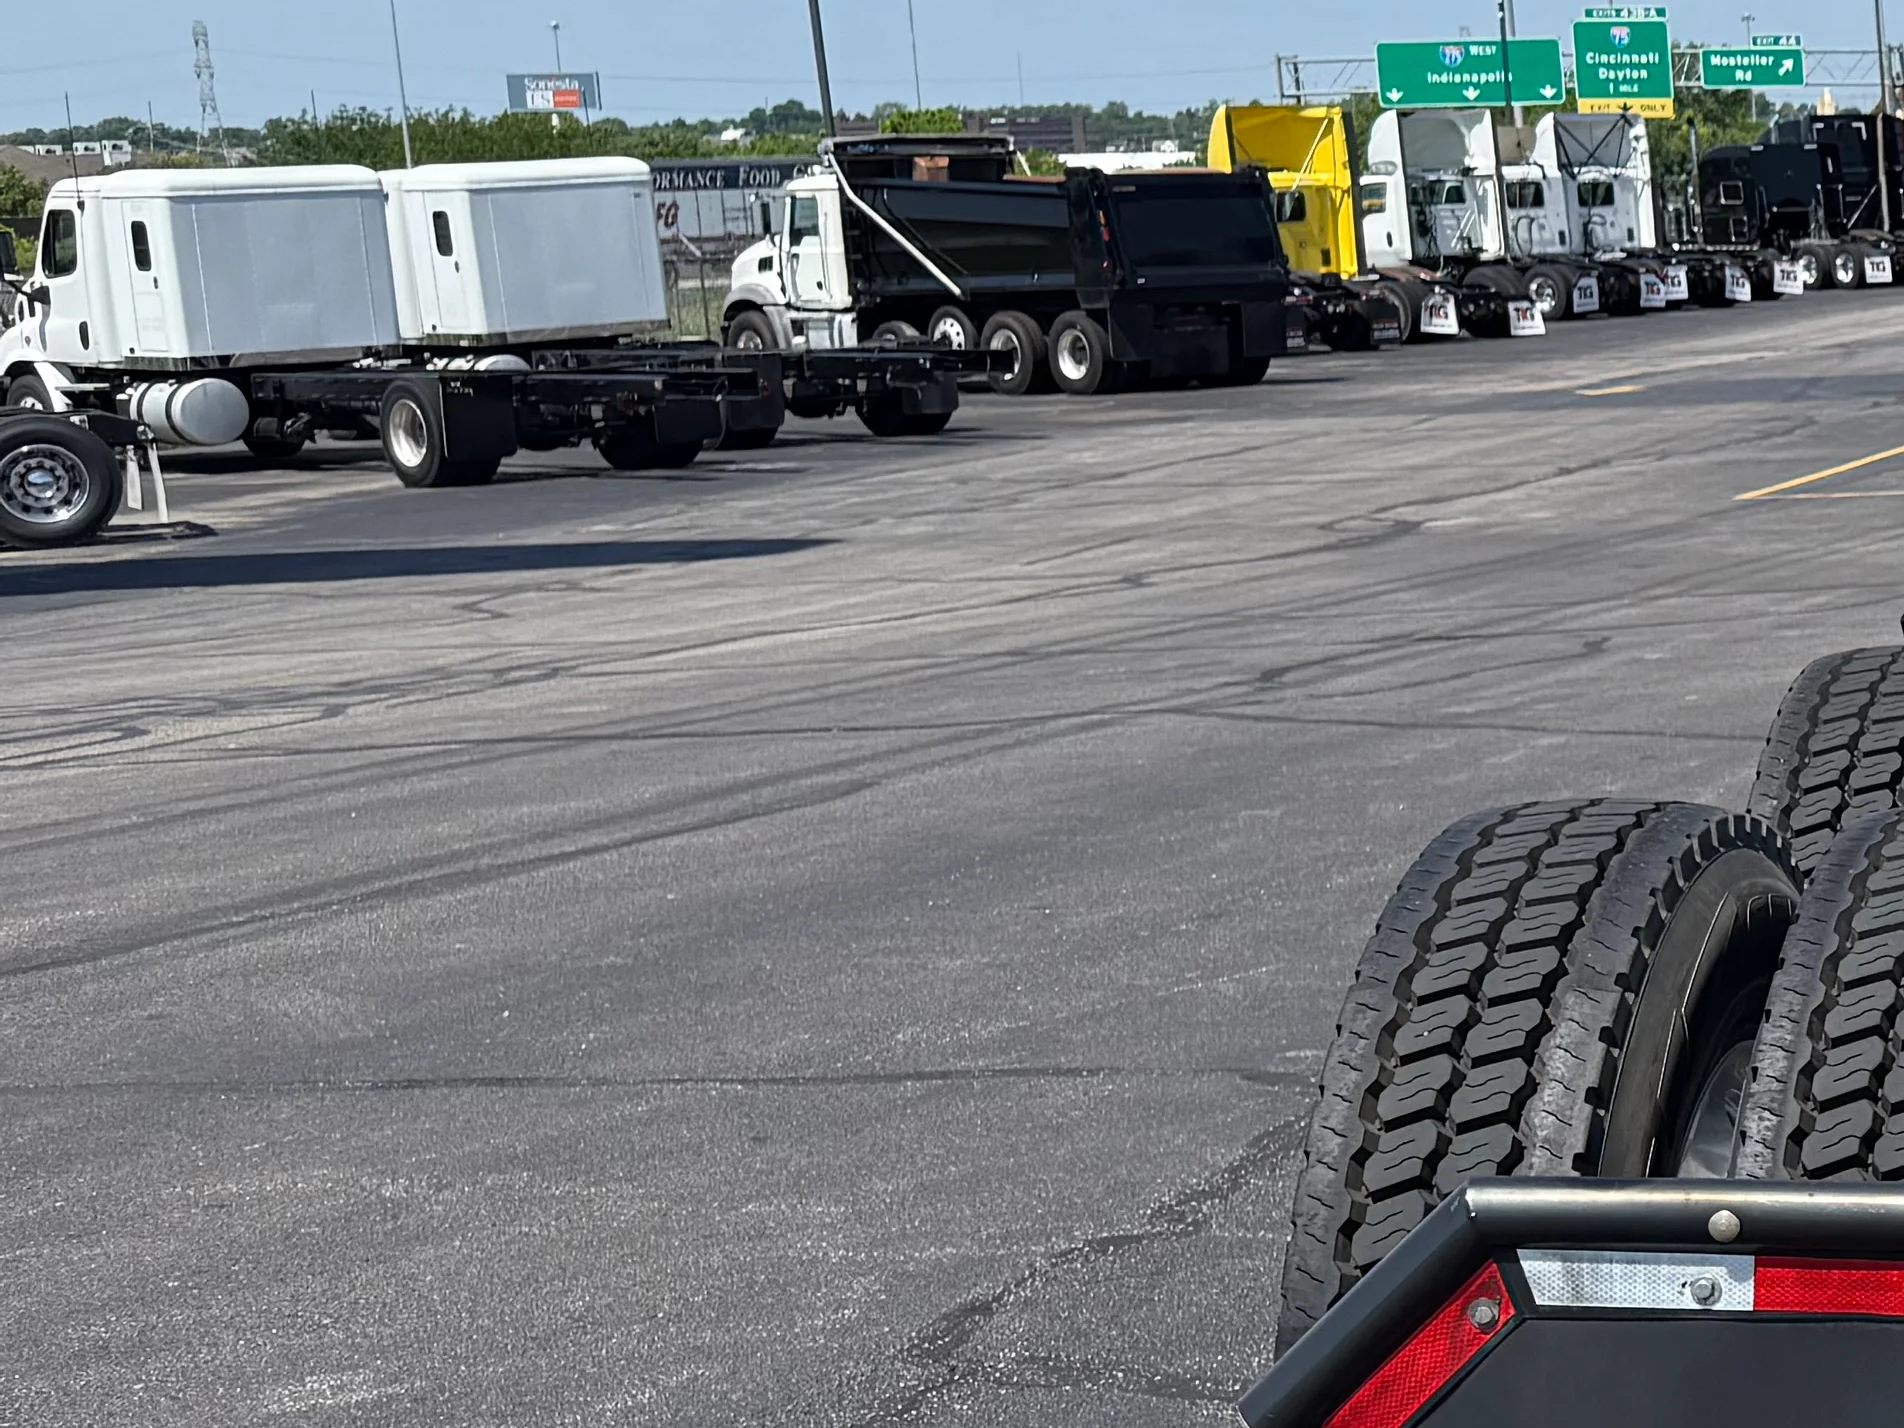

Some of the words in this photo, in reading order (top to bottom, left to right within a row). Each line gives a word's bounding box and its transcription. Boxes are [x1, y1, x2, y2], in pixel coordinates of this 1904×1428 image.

[1469, 45, 1496, 55] WEST
[1586, 52, 1659, 64] Cincinnati
[1710, 54, 1774, 66] Mosteller
[1599, 67, 1648, 81] Dayton
[1735, 69, 1752, 81] Rd
[525, 77, 579, 91] Sonesta
[1640, 104, 1666, 112] ONLY
[739, 166, 780, 187] FOOD
